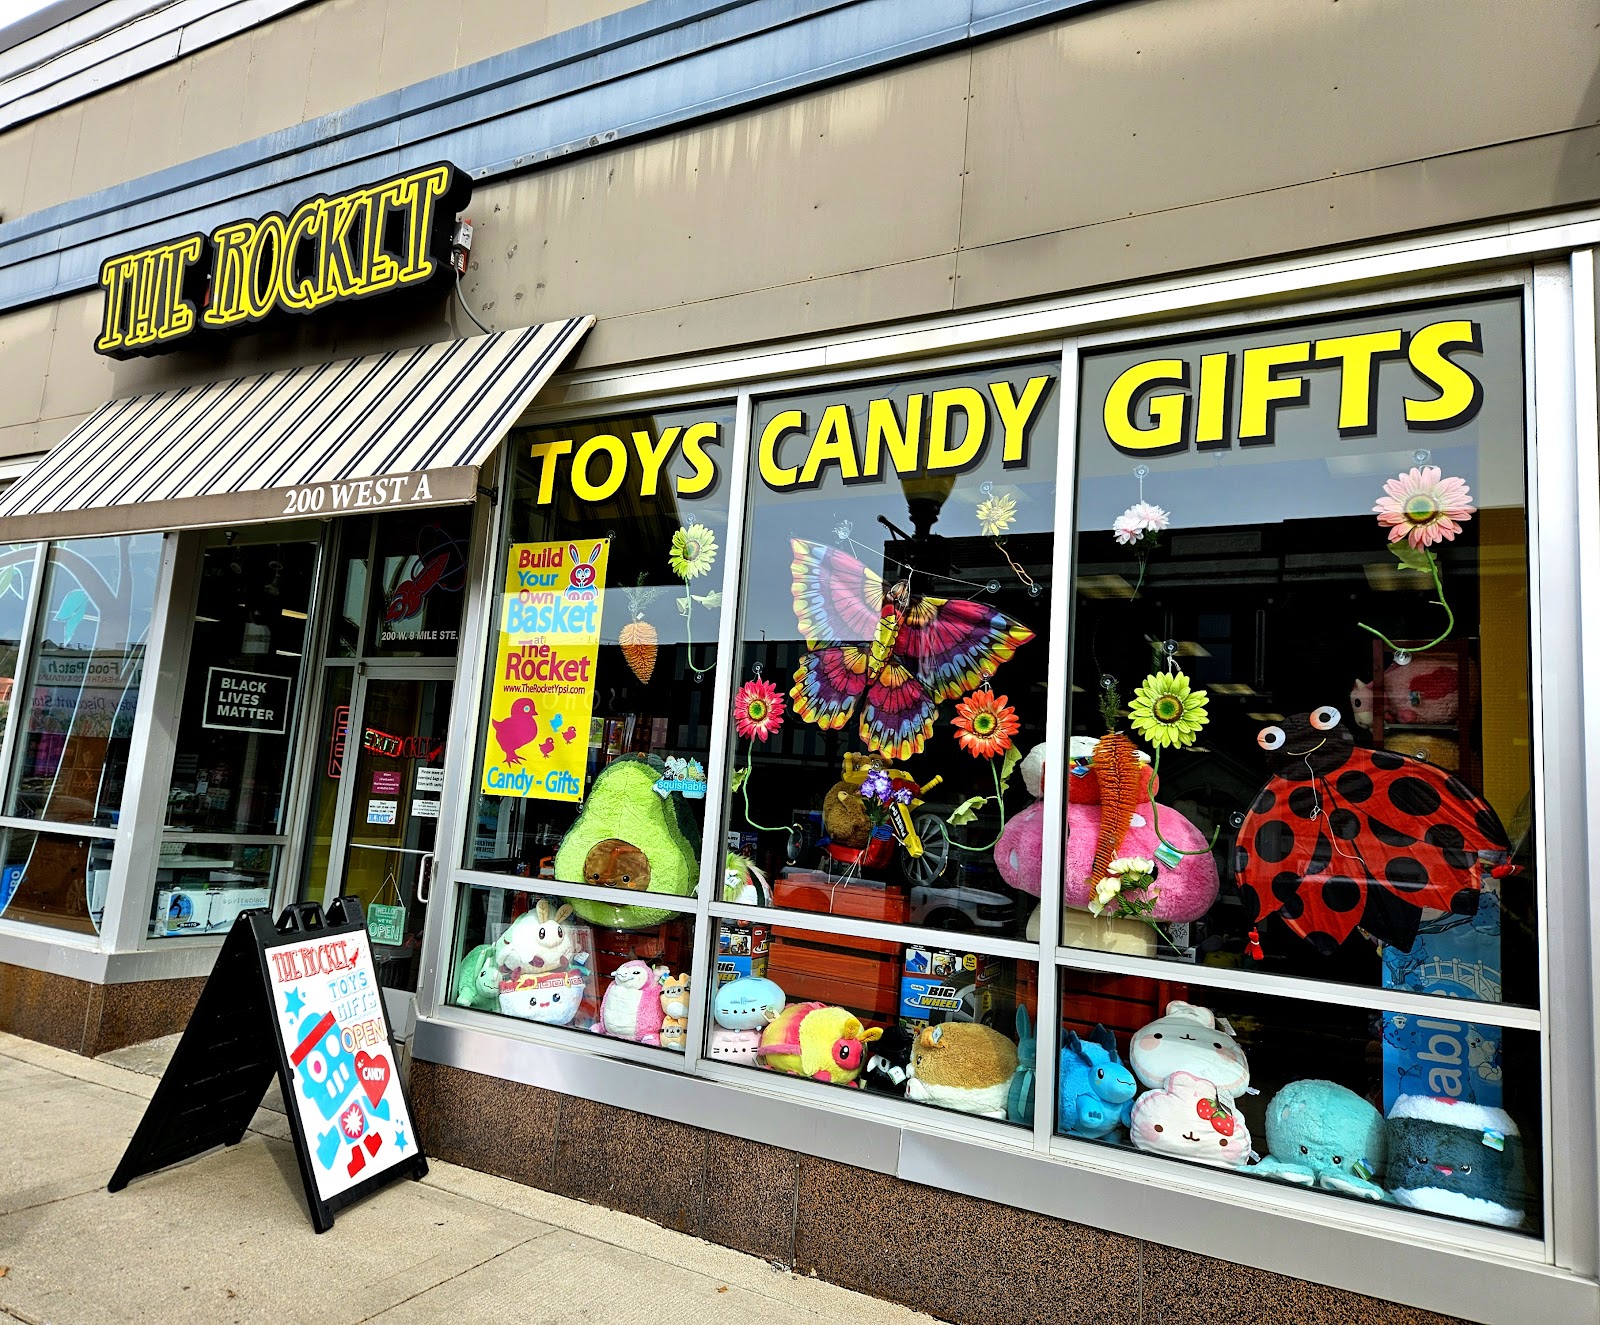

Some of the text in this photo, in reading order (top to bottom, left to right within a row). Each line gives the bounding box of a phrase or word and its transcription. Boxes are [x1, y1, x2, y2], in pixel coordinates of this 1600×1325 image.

[97, 165, 449, 351] THE ROCKET
[530, 319, 1483, 506] TOYS CANDY GIFTS
[282, 474, 433, 514] 200 WEST A
[518, 546, 564, 568] Build
[517, 570, 559, 587] Your
[517, 588, 555, 605] Own
[506, 595, 598, 634] Basket
[381, 630, 459, 640] 200 W. 9 MILE STE.
[533, 635, 546, 645] at
[518, 639, 551, 658] The
[504, 651, 591, 683] Rocket
[220, 677, 268, 694] BLACK
[503, 683, 586, 696] www.TheRocketYpsi.com
[218, 690, 260, 706] LIVES
[216, 704, 275, 721] MATTER
[486, 765, 533, 797] Candy
[544, 770, 581, 795] Gifts
[657, 780, 707, 793] squishable
[368, 922, 401, 940] OPEN
[271, 939, 352, 984] THE ROCKET
[327, 968, 370, 1001] TOYS
[927, 986, 956, 998] BIG
[337, 990, 378, 1022] GIFTS
[920, 996, 958, 1009] WHEEL
[340, 1017, 388, 1054] OPEN
[362, 1067, 386, 1082] CANDY
